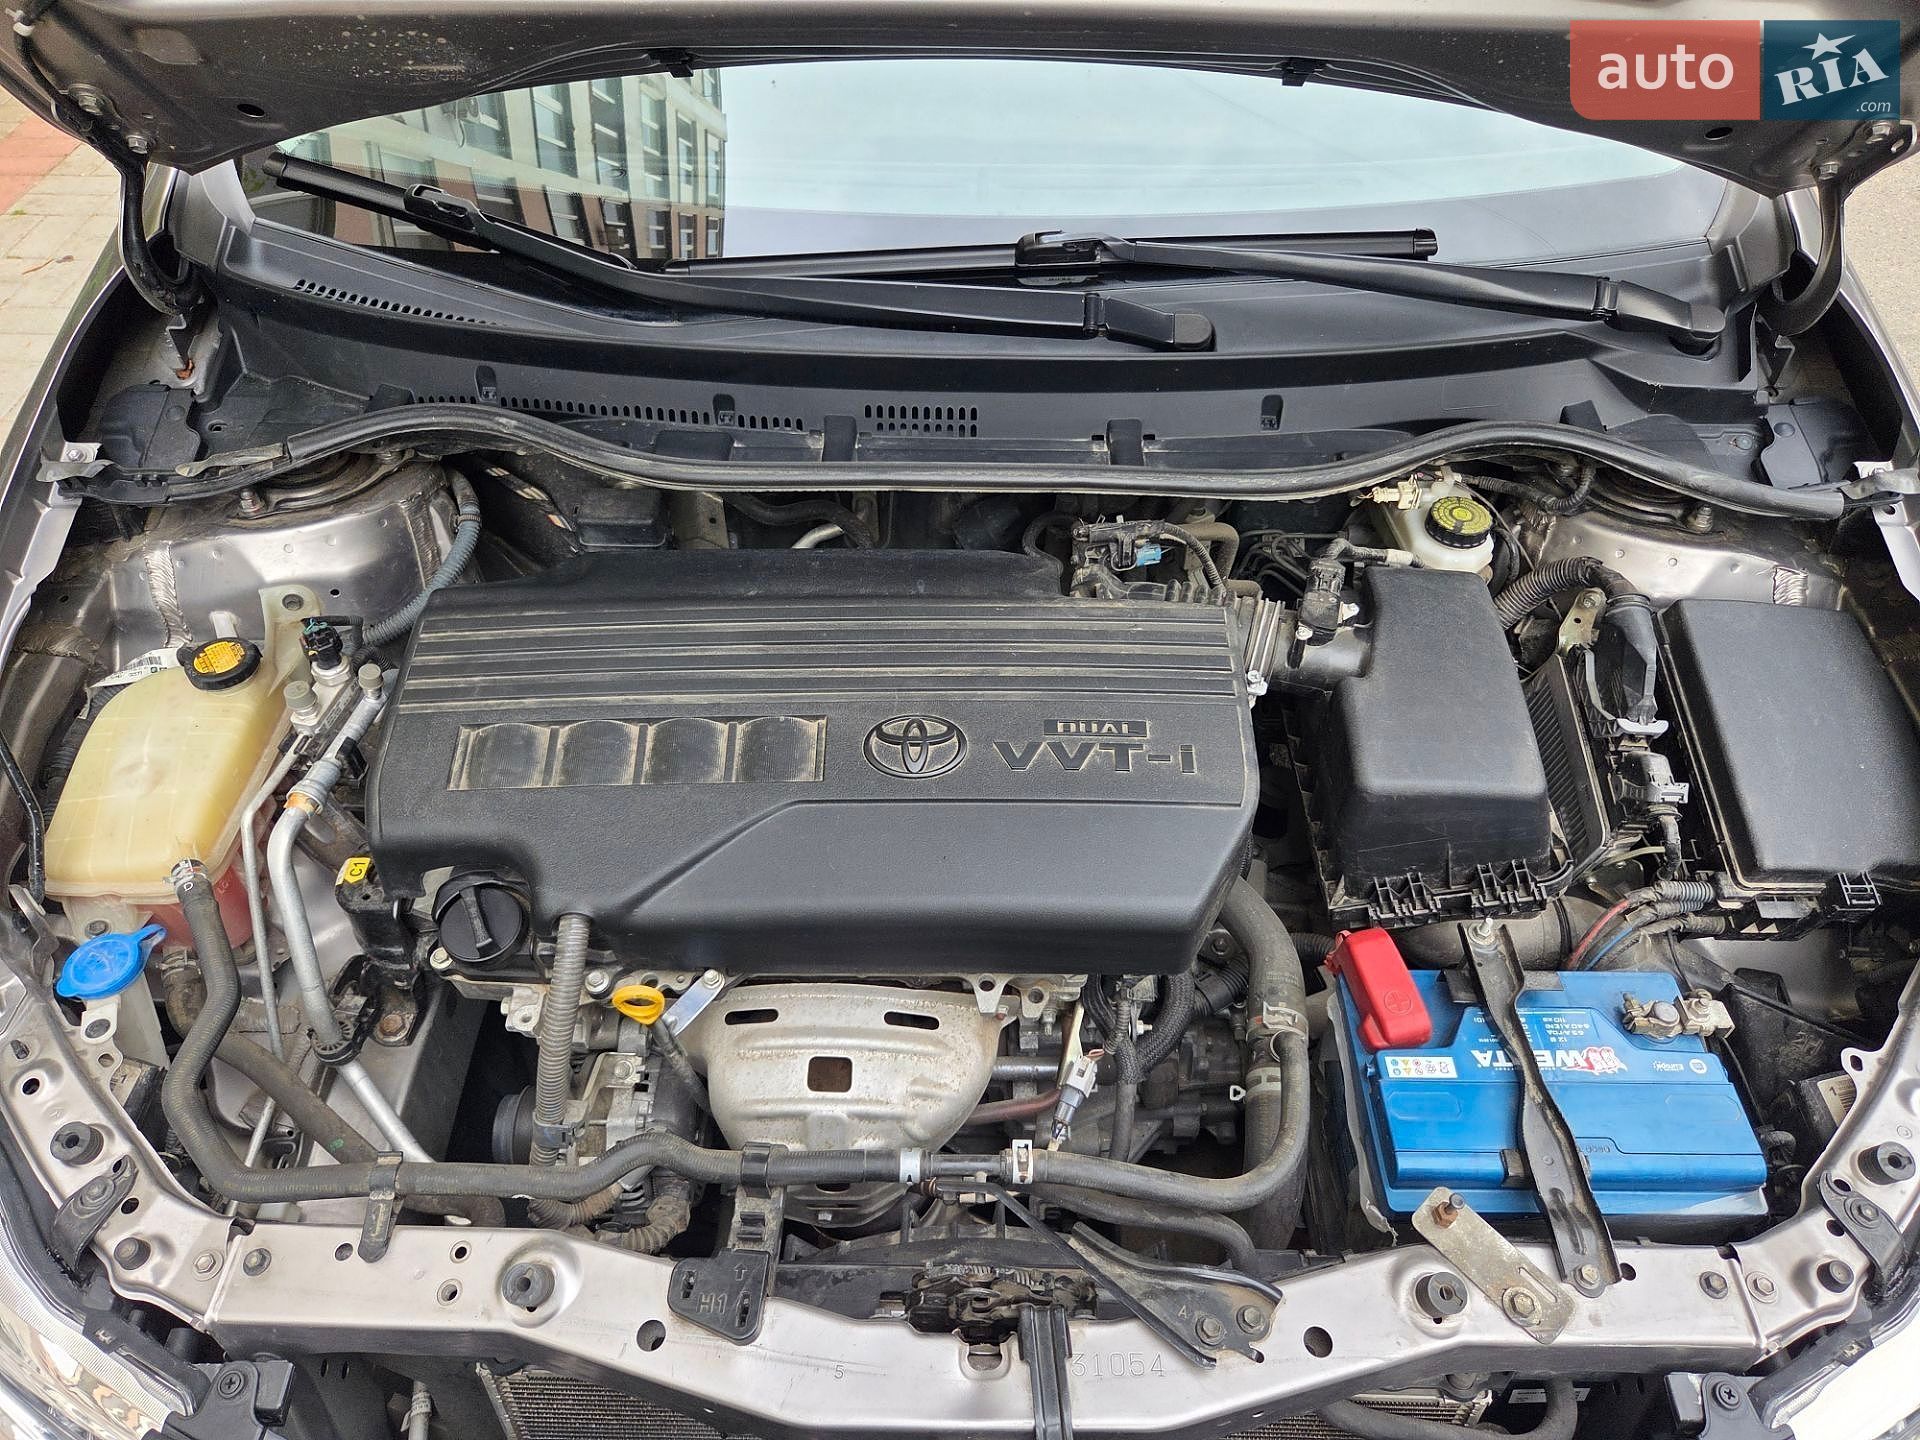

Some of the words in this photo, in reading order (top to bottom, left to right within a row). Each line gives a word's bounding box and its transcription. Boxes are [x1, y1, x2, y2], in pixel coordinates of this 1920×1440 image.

[1056, 720, 1133, 735] DUAL
[350, 862, 367, 876] C1
[1471, 1050, 1586, 1067] WETA
[695, 1292, 728, 1314] H1
[834, 1364, 845, 1379] 5
[1071, 1351, 1167, 1377] 31054
